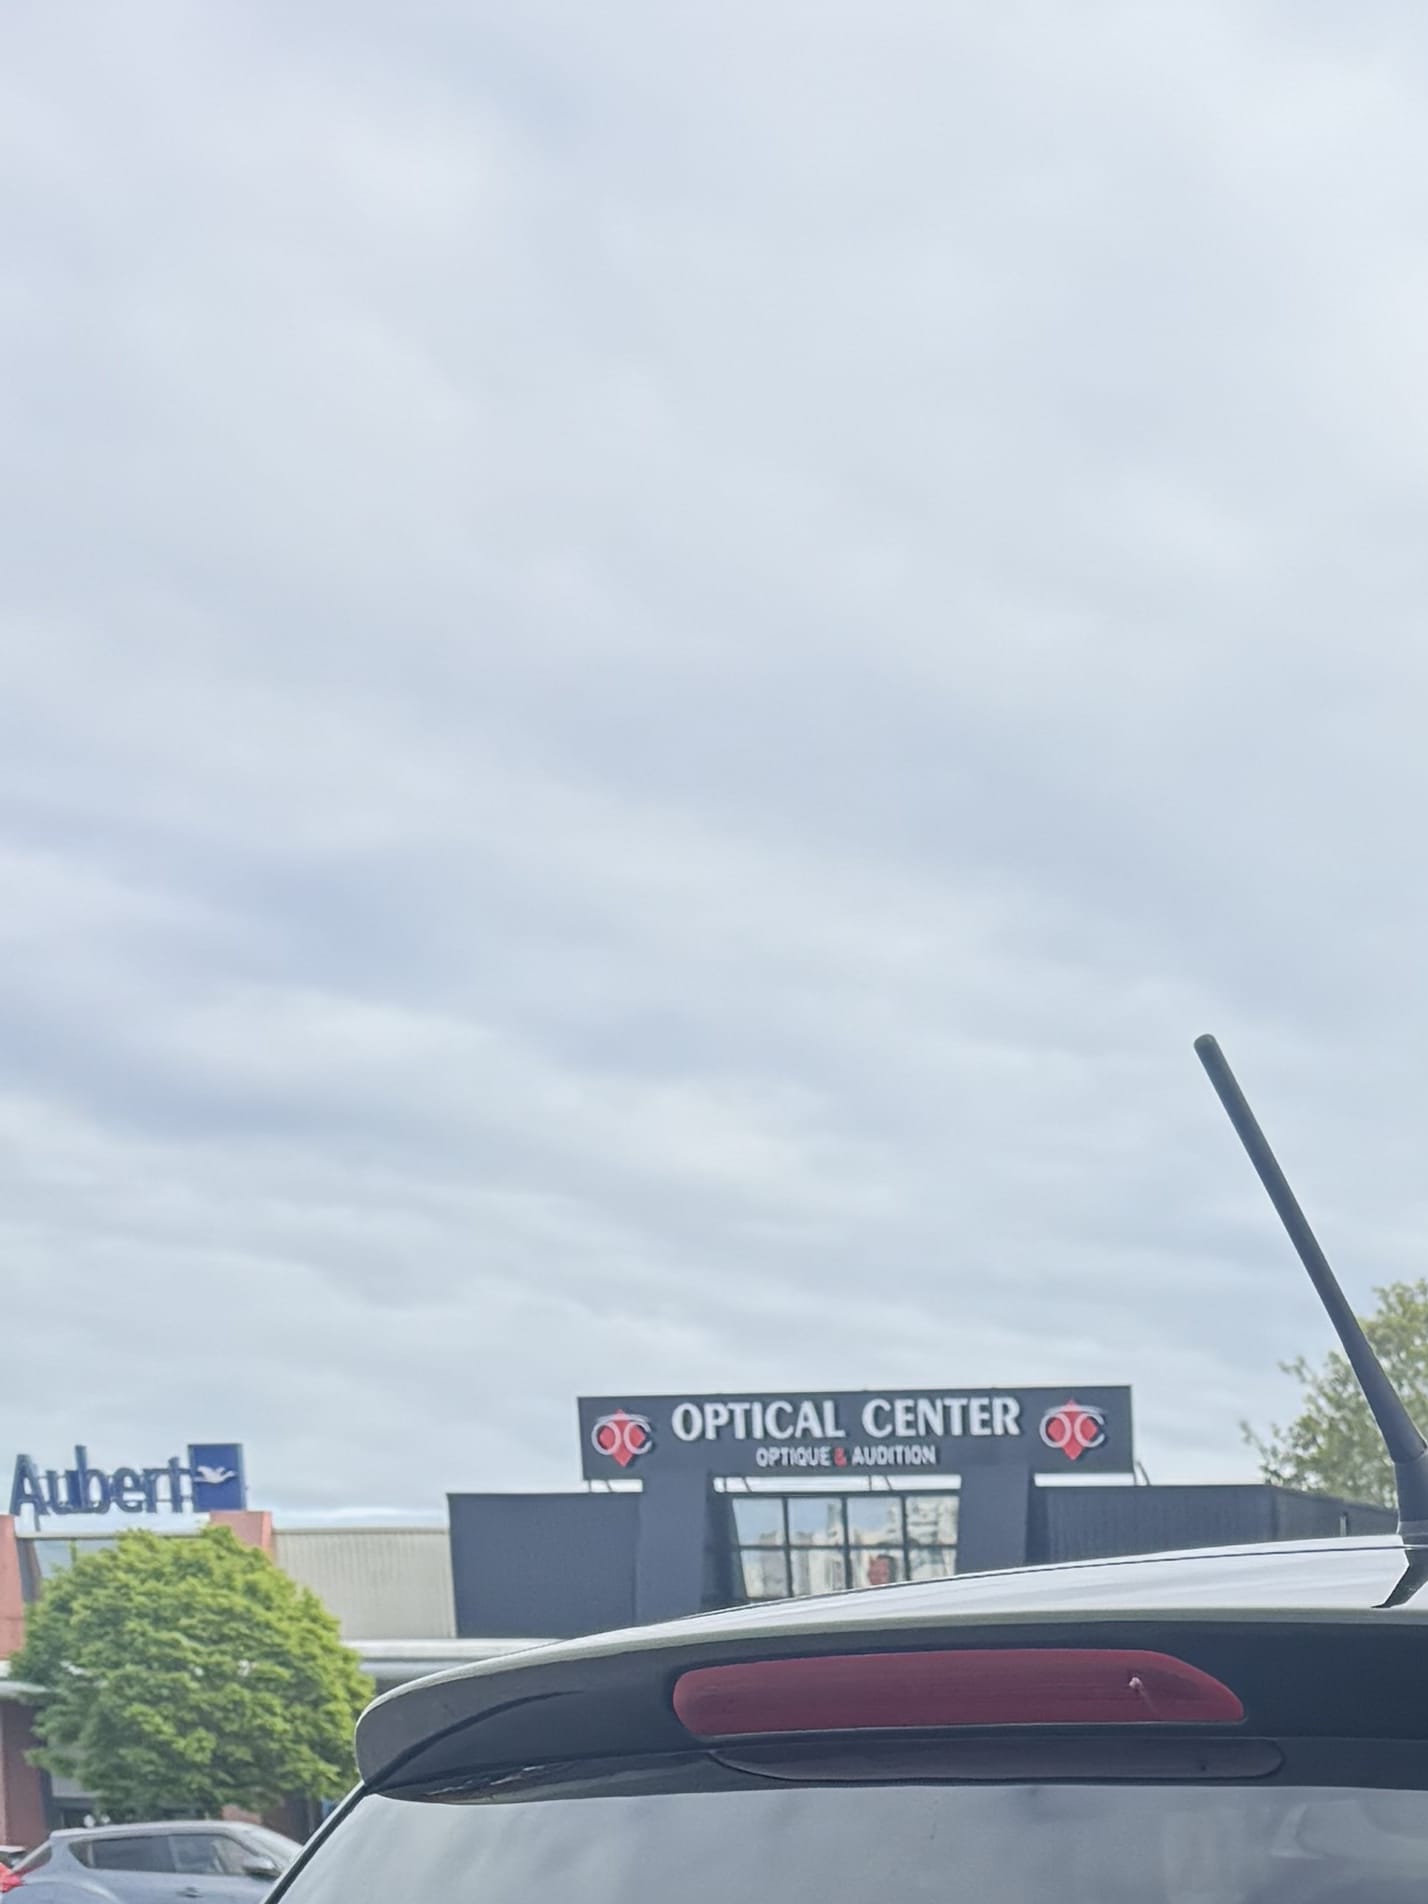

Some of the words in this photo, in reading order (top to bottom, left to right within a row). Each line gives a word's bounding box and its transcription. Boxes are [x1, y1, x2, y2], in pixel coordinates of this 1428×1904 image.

[671, 1399, 846, 1441] OPTICAL
[861, 1396, 1021, 1438] CENTER
[755, 1446, 832, 1467] OPTIQUE
[833, 1446, 848, 1466] &
[852, 1445, 937, 1466] AUDITION
[9, 1444, 193, 1516] Aubert
